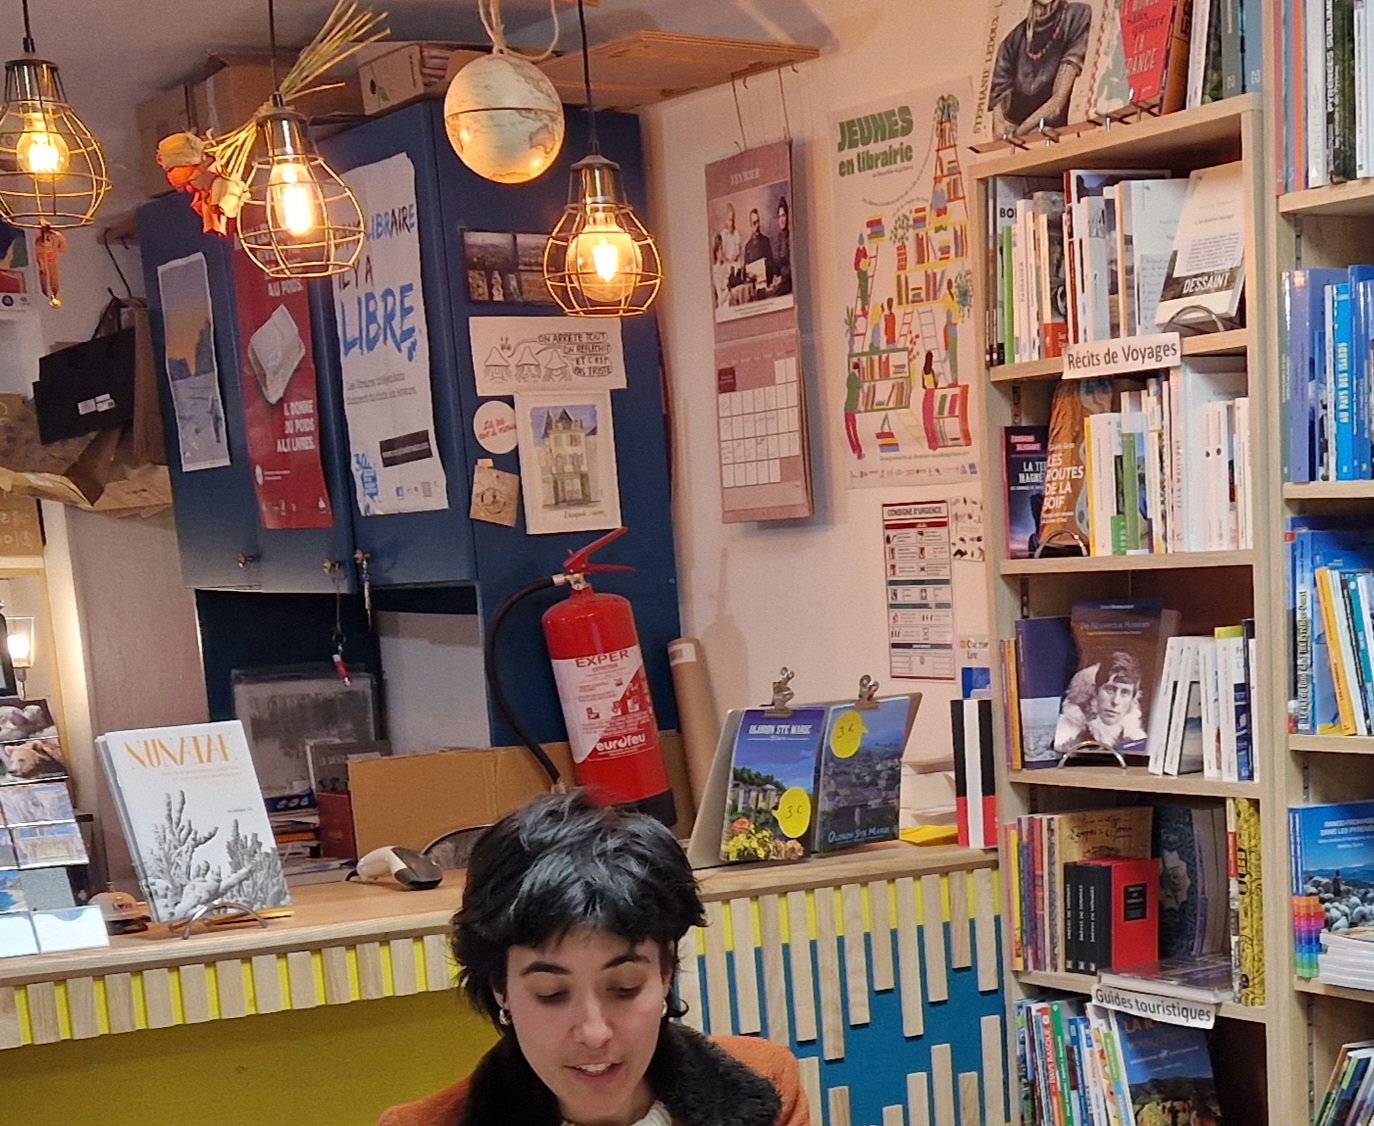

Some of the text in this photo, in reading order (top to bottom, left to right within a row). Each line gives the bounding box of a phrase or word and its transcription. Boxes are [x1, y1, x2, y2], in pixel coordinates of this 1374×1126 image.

[837, 105, 914, 152] JEUNES
[838, 158, 855, 177] en
[856, 142, 914, 173] librairie
[1182, 271, 1231, 295] DESSAINT
[340, 282, 417, 357] LIBRE
[1067, 341, 1178, 371] Récits de Voyages
[1338, 390, 1348, 410] PAYS
[1059, 483, 1072, 496] LA
[1043, 495, 1065, 511] SOIF
[575, 649, 630, 668] EXPER
[595, 734, 646, 752] eurofeu
[1095, 988, 1212, 1023] Guides touristiques
